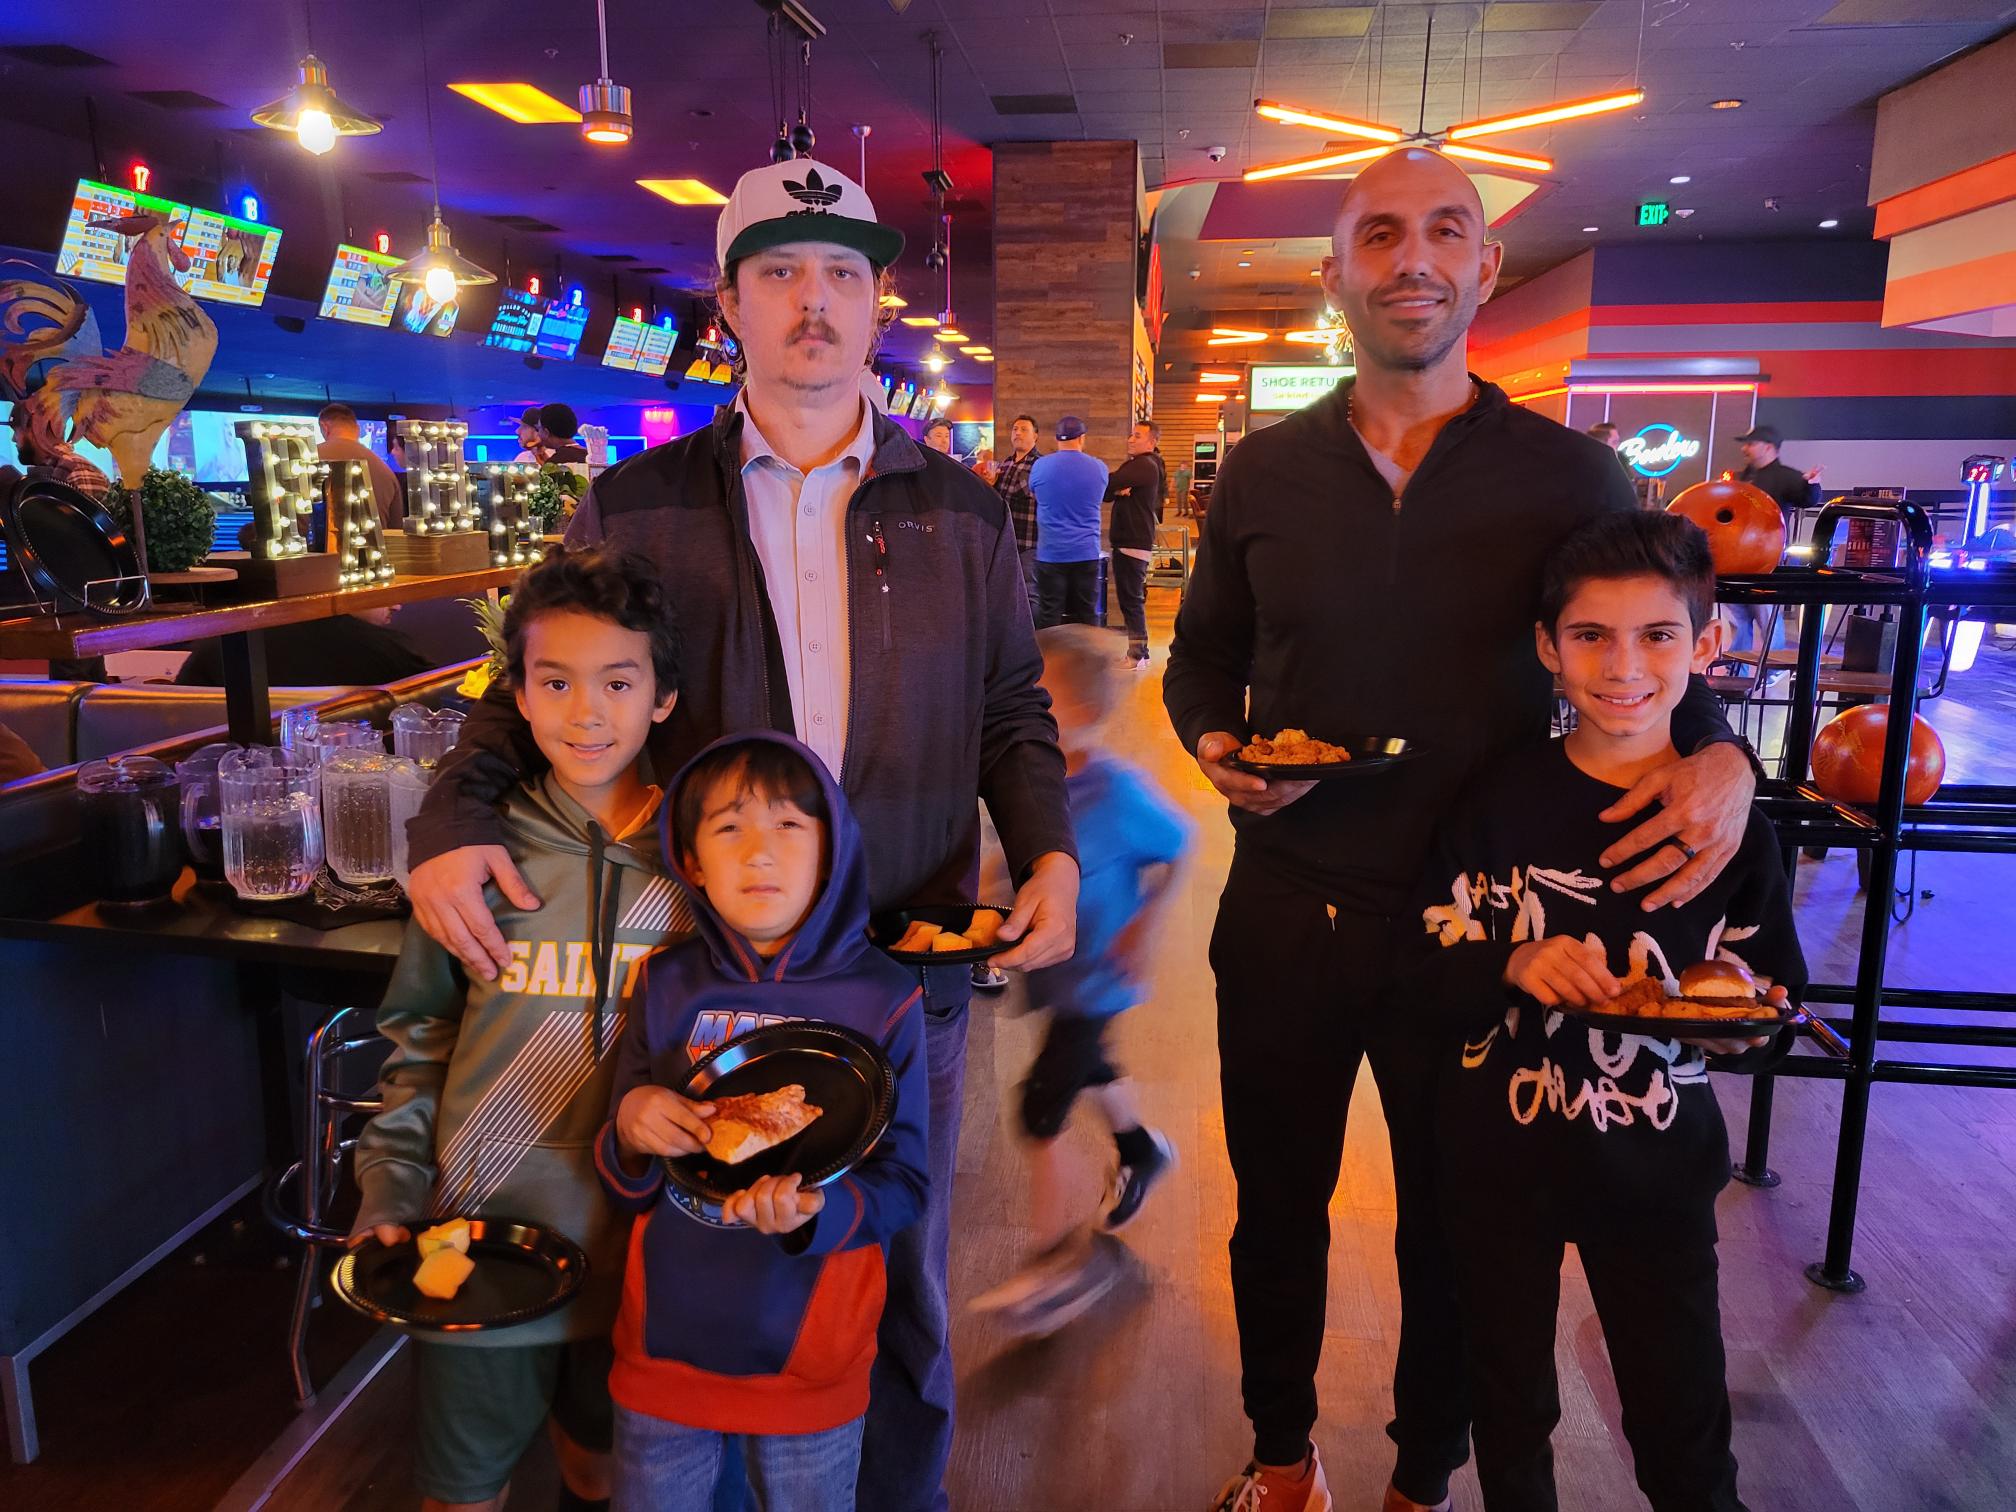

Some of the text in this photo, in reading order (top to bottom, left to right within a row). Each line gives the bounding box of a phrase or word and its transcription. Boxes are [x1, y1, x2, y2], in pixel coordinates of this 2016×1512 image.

[134, 166, 150, 191] 17
[1640, 204, 1666, 226] EXIT
[1261, 376, 1341, 389] SHOE RETU
[898, 520, 935, 533] ORVIS
[500, 940, 654, 998] SAINT
